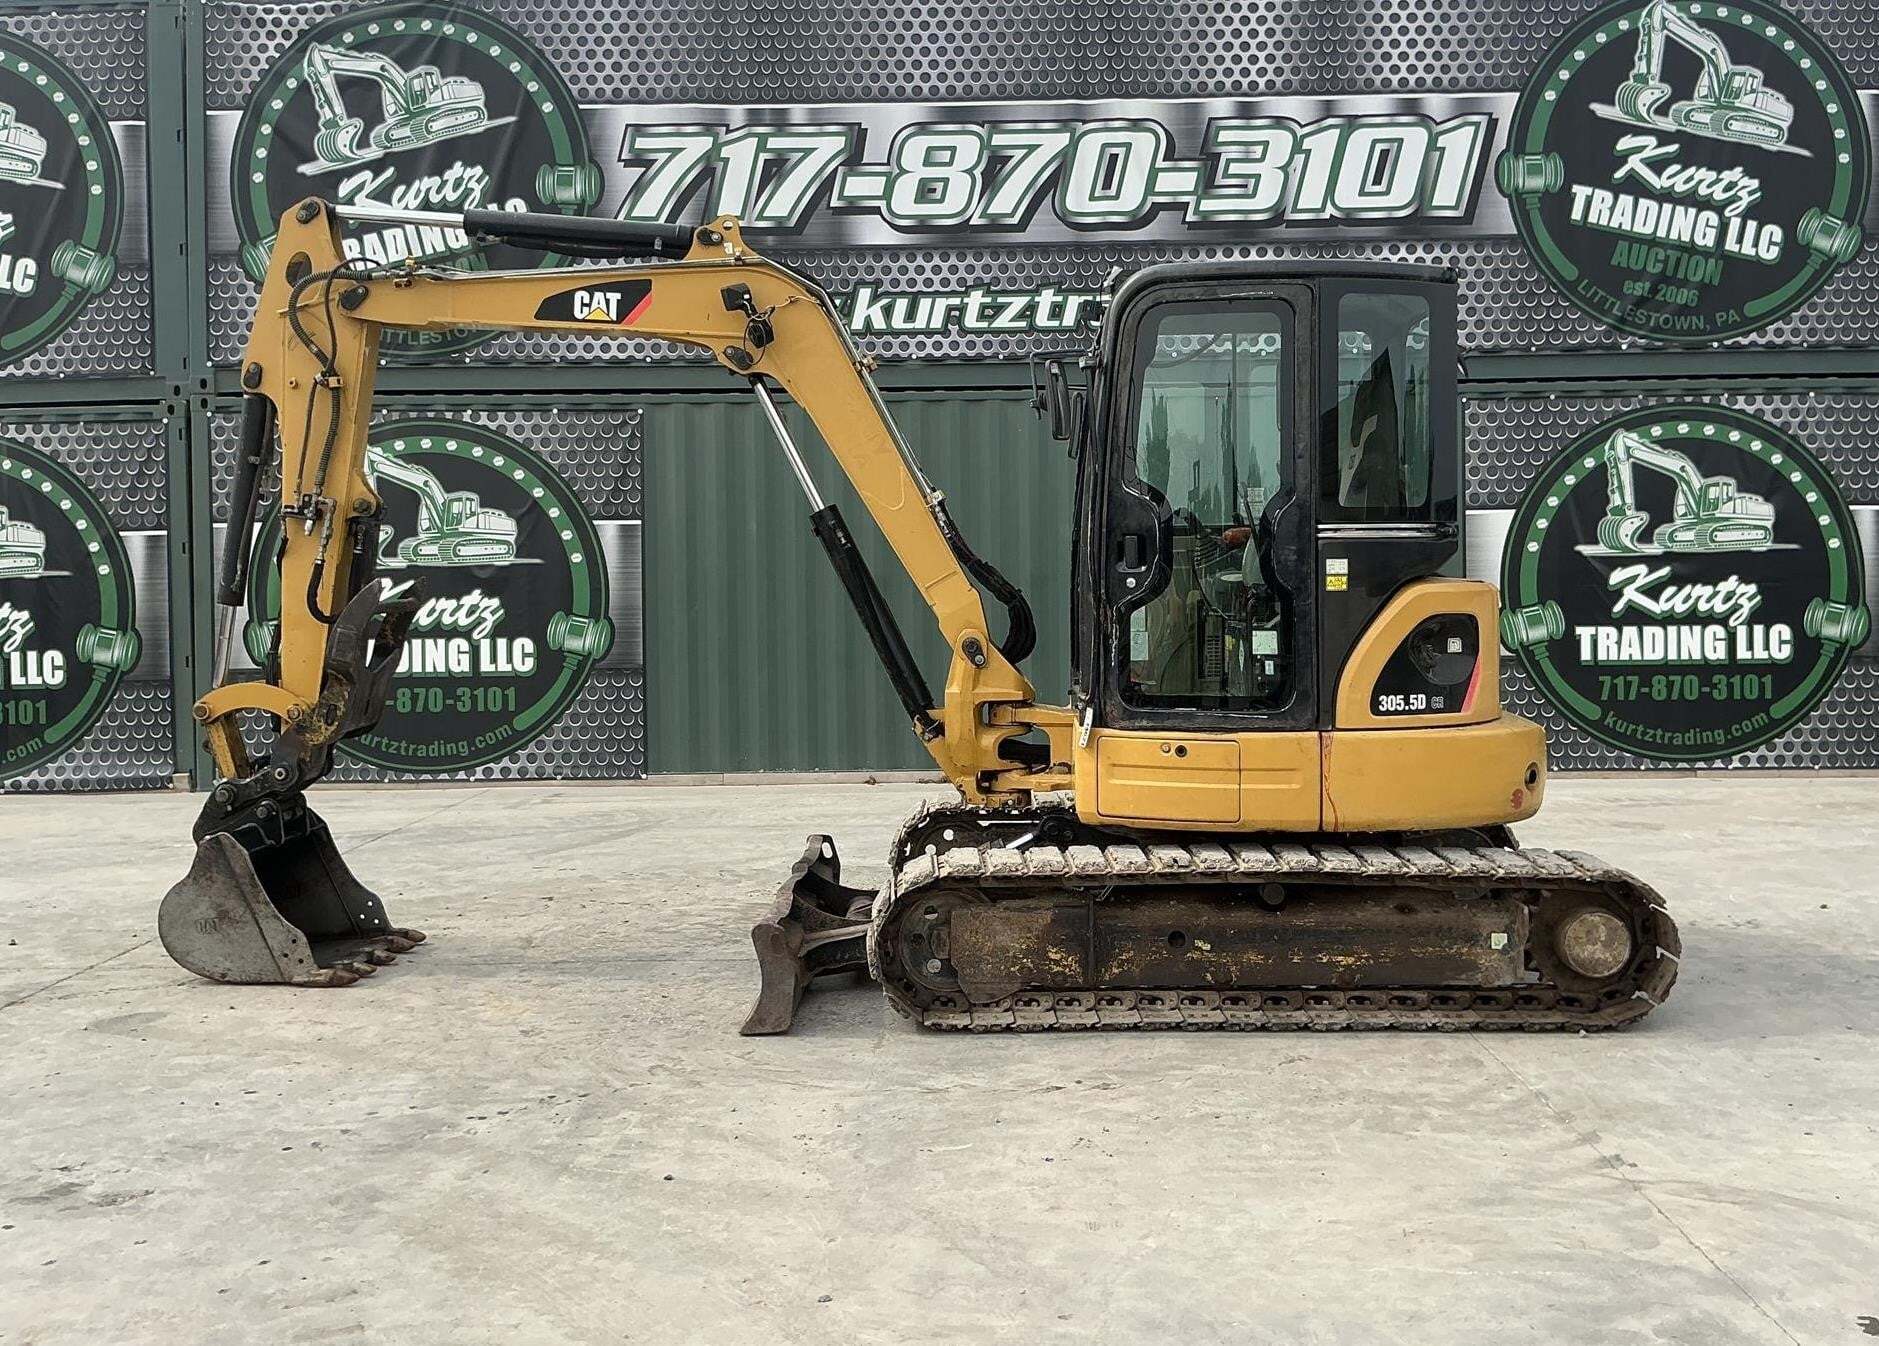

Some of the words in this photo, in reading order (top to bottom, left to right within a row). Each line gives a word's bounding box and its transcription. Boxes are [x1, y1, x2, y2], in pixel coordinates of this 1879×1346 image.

[622, 115, 1485, 225] 717-870-3101
[1612, 134, 1763, 218] Kurtz
[338, 161, 490, 220] Kurtz
[1571, 184, 1720, 249] TRADING
[1724, 216, 1785, 263] LLC
[341, 224, 469, 271] RADING
[1610, 240, 1724, 286] AUCTION
[0, 254, 37, 295] LC
[573, 290, 622, 321] CAT
[1576, 279, 1711, 331] LITTLESTOWN,
[1715, 311, 1742, 327] PA
[1656, 282, 1699, 308] 2006
[1608, 564, 1763, 628] Kurtz
[479, 637, 535, 673] LLC
[1575, 625, 1728, 663] TRADING
[1736, 624, 1793, 662] LLC
[10, 650, 65, 686] LLC
[1599, 674, 1773, 701] 717-870-3101
[385, 686, 517, 713] -870-3101
[1378, 693, 1427, 712] 305.5D
[359, 723, 513, 758] urtztrading.com
[1603, 711, 1770, 746] kurtztrading.com
